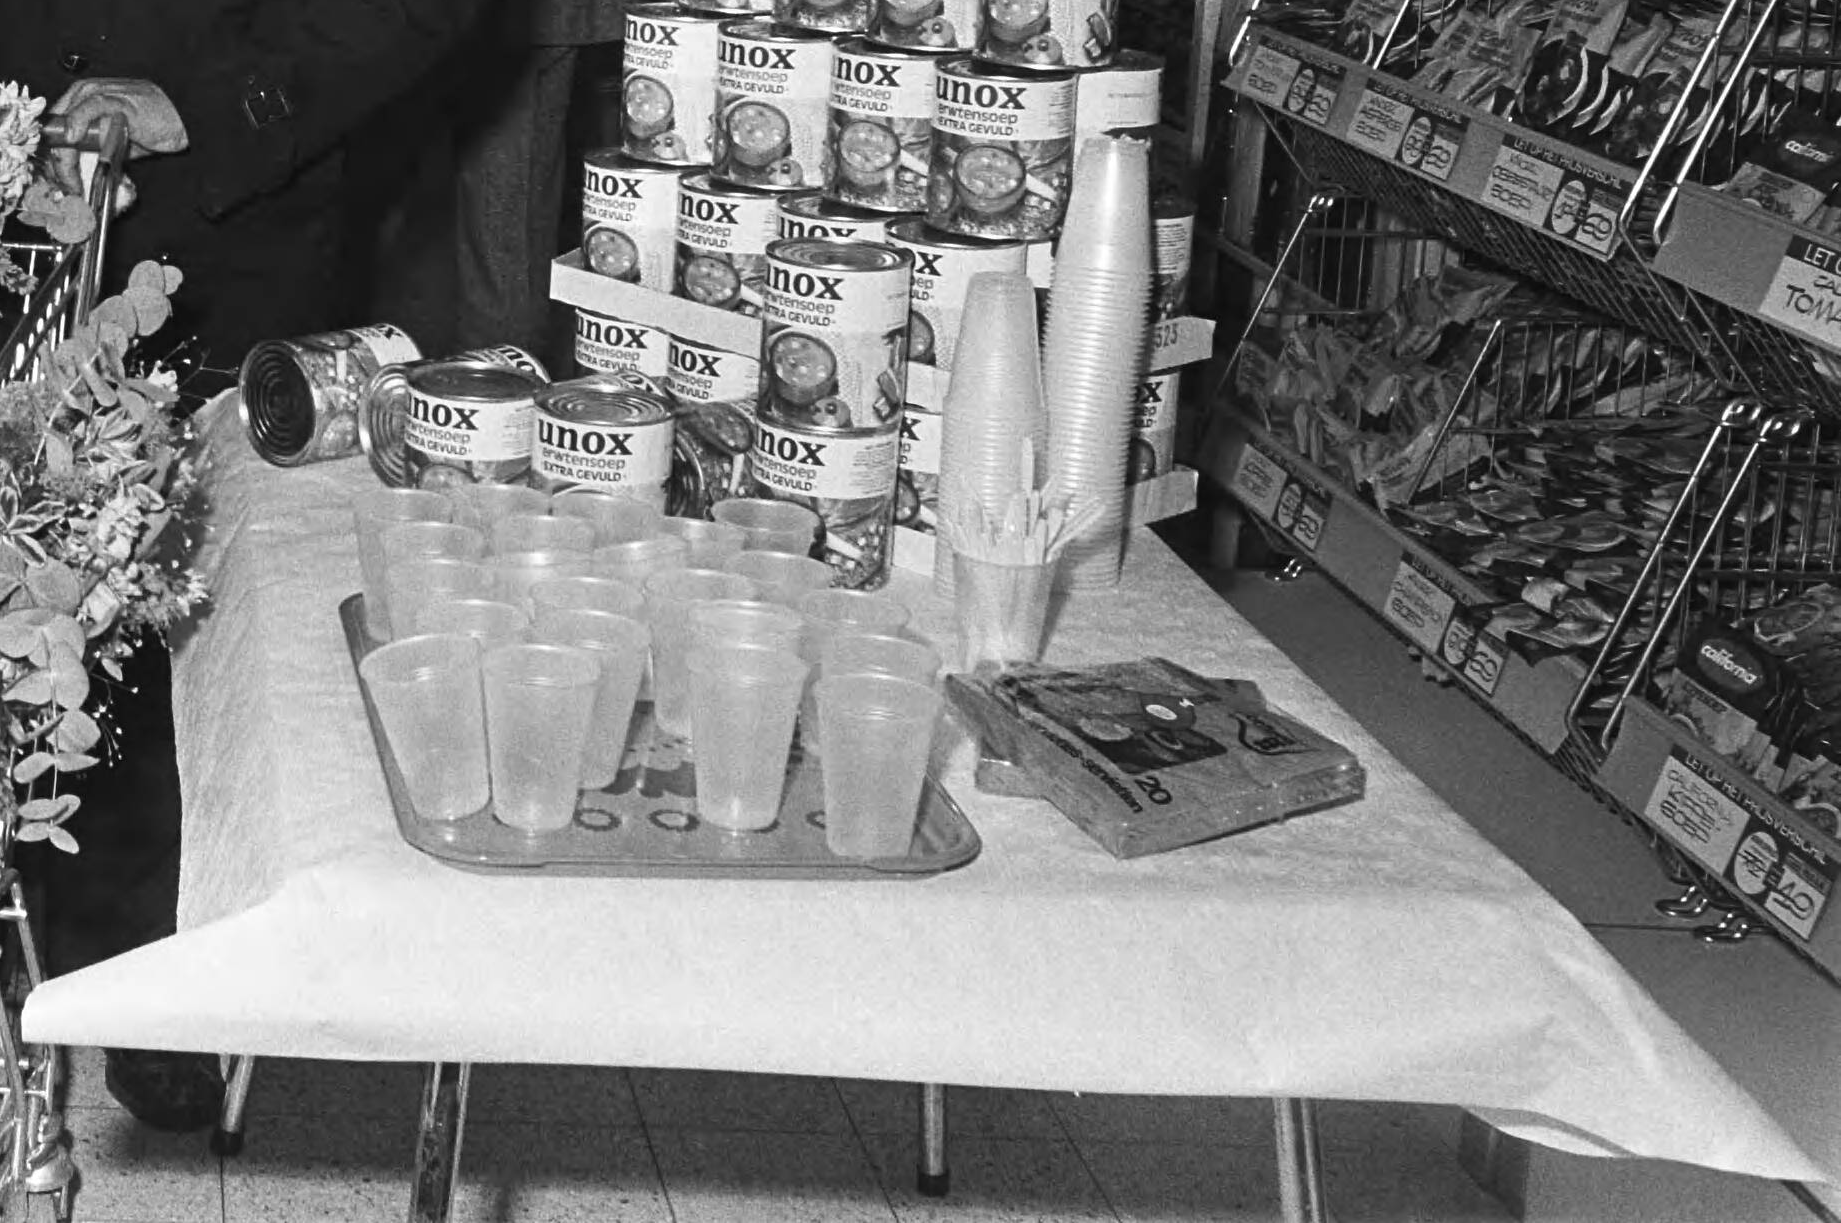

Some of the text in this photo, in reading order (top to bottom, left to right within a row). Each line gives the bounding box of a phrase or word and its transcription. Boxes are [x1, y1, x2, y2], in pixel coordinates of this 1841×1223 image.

[626, 18, 680, 47] nox
[836, 55, 902, 88] nox
[936, 74, 1027, 110] unox
[969, 123, 1013, 137] GEVULD
[586, 168, 644, 200] nox
[679, 192, 741, 225] nox
[1803, 243, 1836, 269] LET
[669, 340, 723, 379] nox
[410, 394, 480, 430] nox
[537, 418, 635, 457] unox
[760, 428, 828, 467] nox
[578, 466, 622, 483] GEVULD
[1134, 775, 1173, 806] 20
